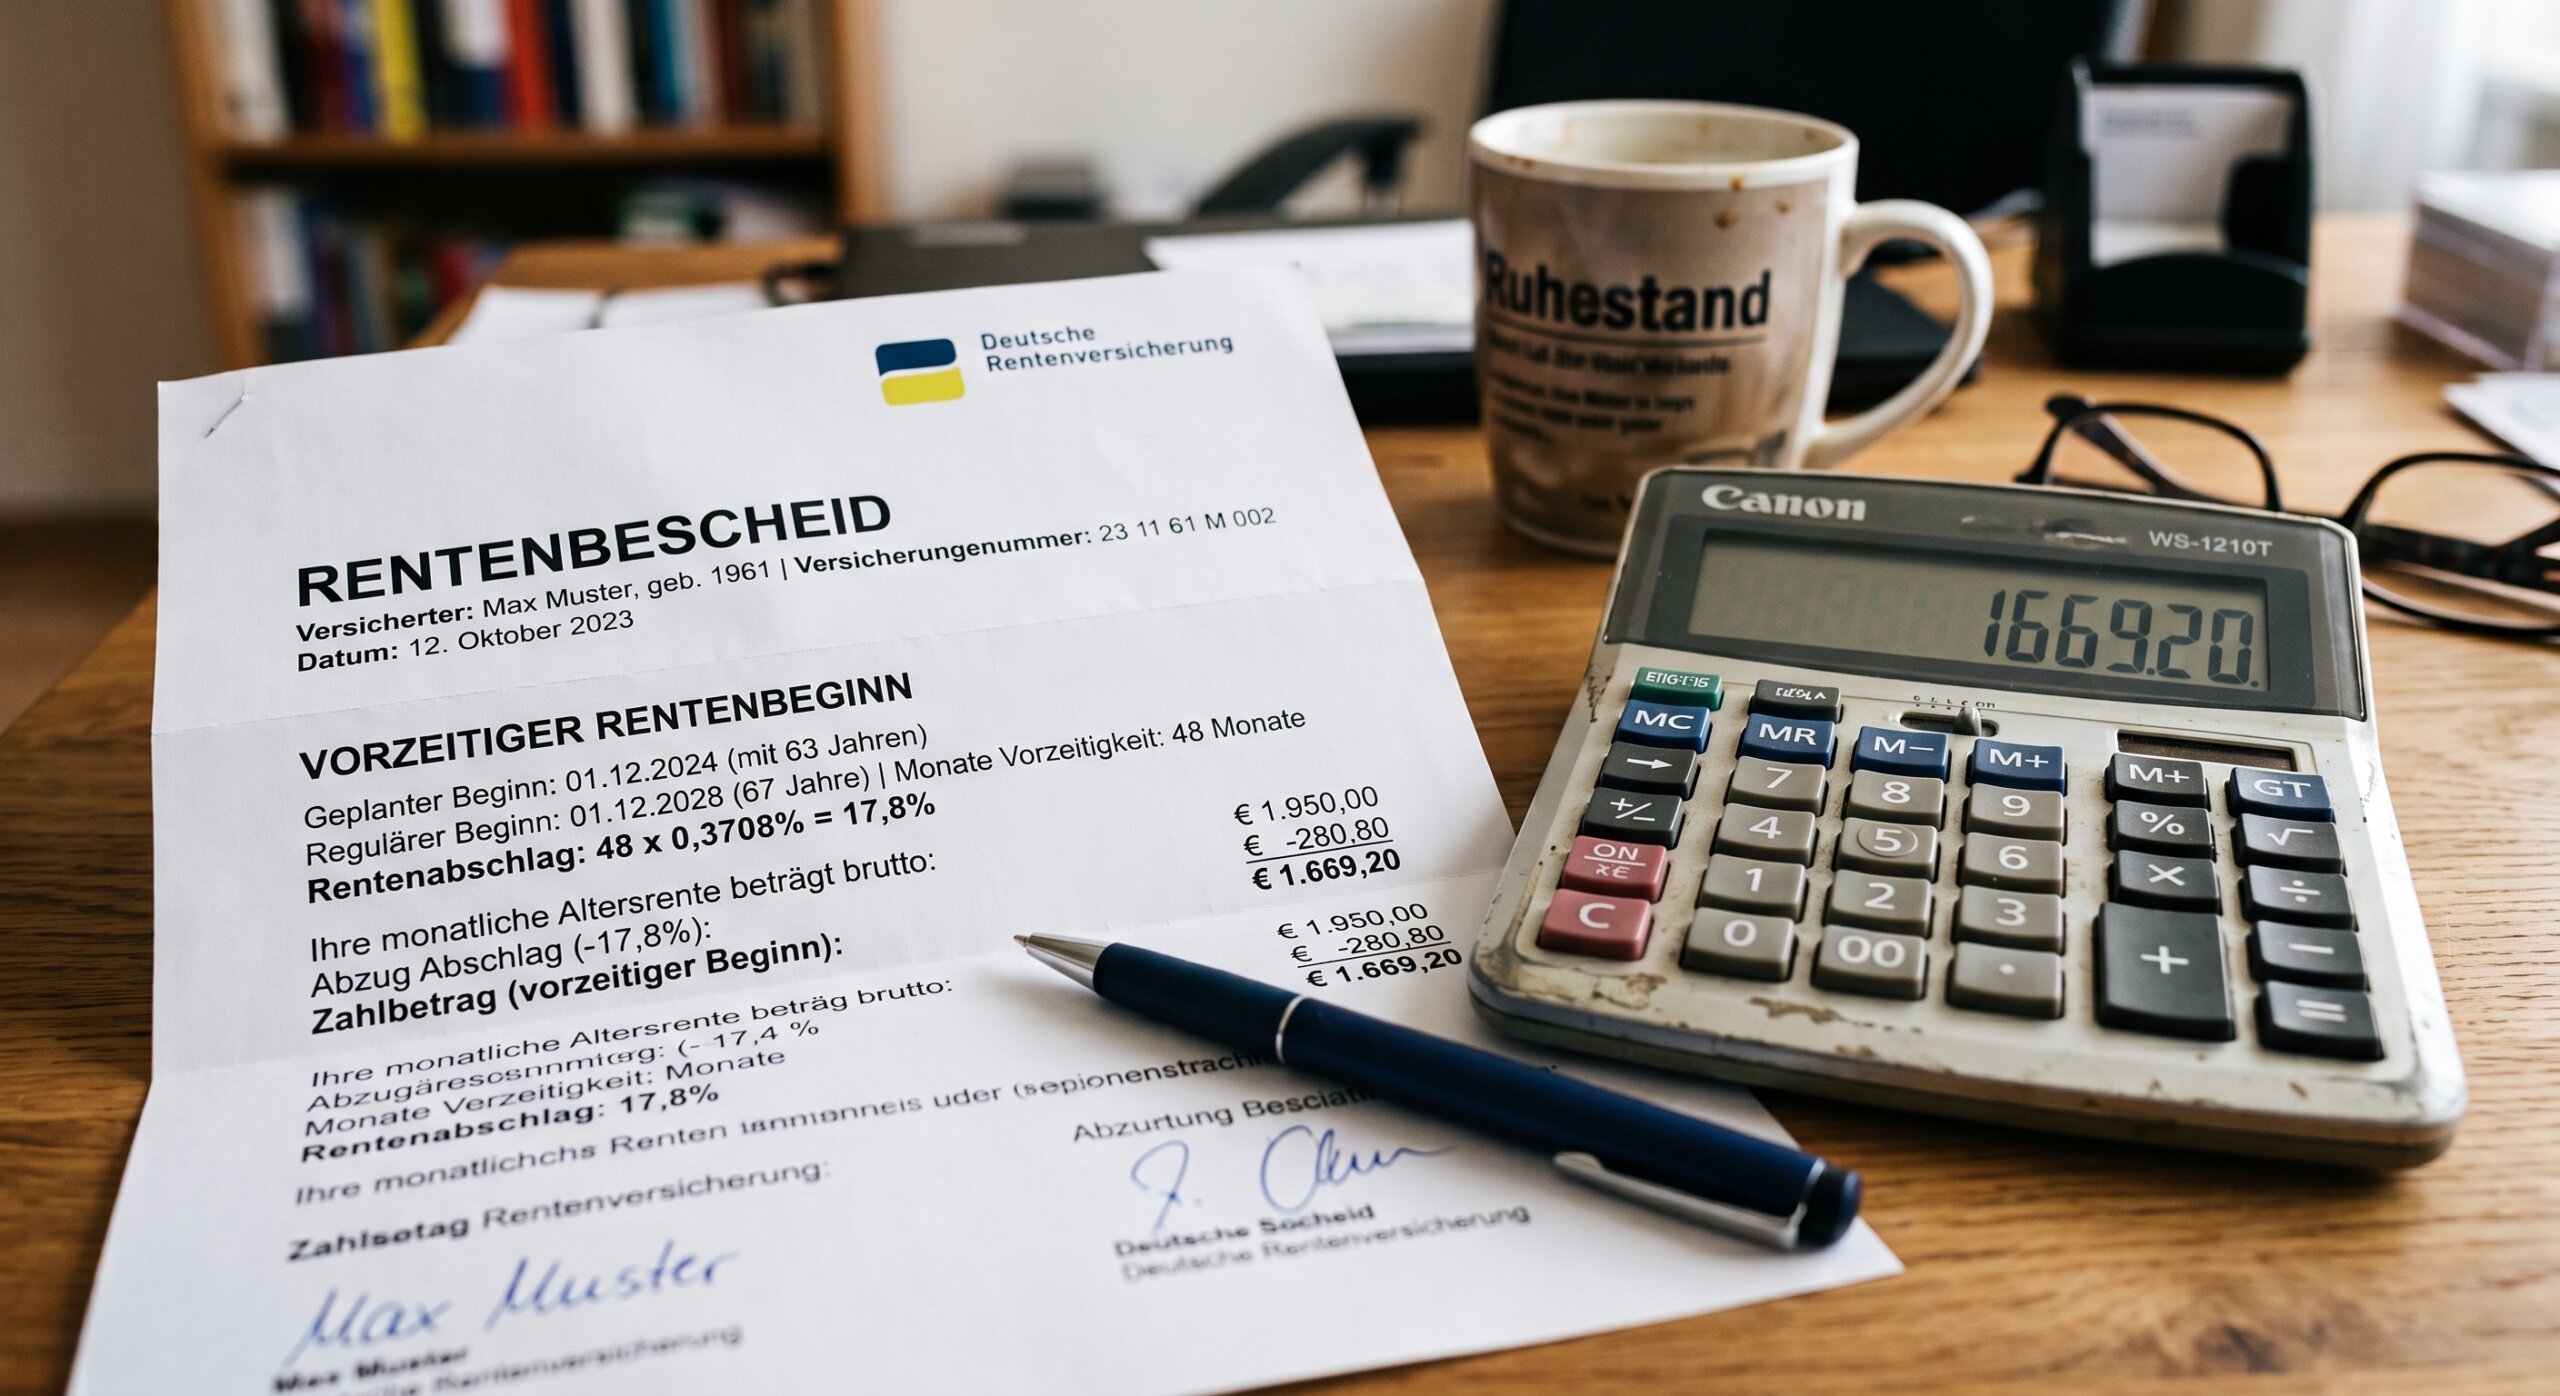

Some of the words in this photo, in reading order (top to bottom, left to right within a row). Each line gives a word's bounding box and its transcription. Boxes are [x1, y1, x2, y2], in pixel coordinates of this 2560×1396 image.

[1484, 250, 1771, 333] Ruhestand
[981, 327, 1094, 350] Deutsche
[986, 338, 1233, 372] Rentenversicherung
[1701, 483, 1866, 521] Canon
[297, 495, 892, 607] RENTENBESCHEID
[2148, 530, 2273, 557] WS-1210T
[296, 606, 473, 642] Versicherter:
[483, 598, 538, 617] Max
[546, 583, 638, 609] Muster,
[648, 572, 701, 599] geb.
[711, 560, 768, 584] 1961
[794, 531, 1091, 573] Versicherungenummer:
[1099, 523, 1128, 542] 23
[1137, 520, 1159, 536] 11
[1169, 516, 1195, 534] 61
[1205, 512, 1226, 529] M
[1233, 508, 1275, 527] 002
[298, 646, 397, 672] Datum:
[410, 636, 447, 656] 12.
[458, 624, 561, 650] Oktober
[570, 610, 633, 635] 2023
[299, 716, 585, 780] VORZEITIGER
[595, 672, 913, 740] RENTENBEGINN
[1634, 709, 1694, 731] MC
[1758, 722, 1816, 747] MR
[304, 794, 443, 829] Geplanter
[453, 779, 556, 808] Beginn:
[566, 751, 718, 792] 01.12.2024
[728, 743, 778, 775] (mit
[785, 738, 818, 761] 63
[828, 723, 927, 756] Jahren)
[1988, 748, 2049, 768] M+
[2128, 764, 2190, 785] M+
[307, 830, 446, 866] Regulärer
[455, 814, 560, 844] Beginn:
[570, 786, 724, 827] 01.12.2028
[734, 778, 774, 809] (67
[785, 765, 869, 796] Jahre)
[894, 752, 993, 782] Monate
[999, 728, 1164, 767] Vorzeitigkeit:
[1172, 721, 1204, 743] 48
[1211, 710, 1305, 738] Monate
[1765, 767, 1794, 790] 7
[1882, 781, 1911, 804] 8
[2254, 779, 2311, 798] GT
[1234, 803, 1253, 825] €
[1262, 786, 1378, 821] 1.950,00
[2002, 795, 2031, 817] 9
[2140, 811, 2185, 836] %
[1243, 835, 1263, 856] €
[1286, 817, 1389, 850] -280,80
[1748, 816, 1782, 840] 4
[1872, 829, 1903, 853] 5
[308, 846, 585, 904] Rentenabschlag:
[596, 834, 633, 859] 48
[642, 834, 663, 854] x
[672, 809, 804, 853] 0,3708%
[814, 811, 832, 824] =
[843, 791, 935, 826] 17,8%
[1593, 843, 1638, 860] ON
[1998, 844, 2028, 871] 6
[1252, 867, 1272, 890] €
[1280, 848, 1400, 886] 1.669,20
[1746, 868, 1763, 892] 1
[312, 937, 370, 962] Ihre
[382, 908, 549, 951] monatliche
[558, 882, 721, 925] Altersrente
[730, 863, 835, 899] beträgt
[843, 852, 935, 882] brutto:
[1867, 882, 1896, 910] 2
[1997, 898, 2027, 926] 3
[1277, 923, 1298, 939] €
[1306, 903, 1428, 935] 1.950,00
[1578, 903, 1616, 929] C
[1723, 920, 1757, 948] 0
[311, 966, 410, 998] Abzug
[420, 943, 562, 982] Abschlag
[574, 917, 710, 964] (-17,8%):
[1290, 945, 1312, 962] €
[1338, 925, 1444, 954] -280,80
[1837, 937, 1905, 969] 00
[312, 989, 496, 1035] Zahlbetrag
[509, 958, 696, 1010] (vorzeitiger
[706, 933, 842, 974] Beginn):
[1306, 970, 1328, 987] €
[1336, 949, 1462, 982] 1.669,20
[312, 1069, 373, 1087] Ihre
[386, 1040, 560, 1077] monatliche
[570, 1012, 740, 1048] Altersrente
[751, 996, 847, 1020] beträg
[857, 980, 952, 1004] brutto:
[305, 1107, 430, 1137] Monate
[443, 1071, 652, 1114] Verzeitigkeit:
[666, 1052, 785, 1080] Monate
[301, 1104, 604, 1163] Rentenabschlag:
[620, 1083, 719, 1113] 17,8%
[296, 1184, 360, 1204] Ihre
[611, 1126, 726, 1154] Renten
[934, 1088, 1000, 1107] uder
[483, 1160, 830, 1228] Rentenversicherung:
[1113, 1226, 1250, 1258] Deutsche
[280, 1287, 451, 1370] Max
[483, 1239, 740, 1333] Muster
